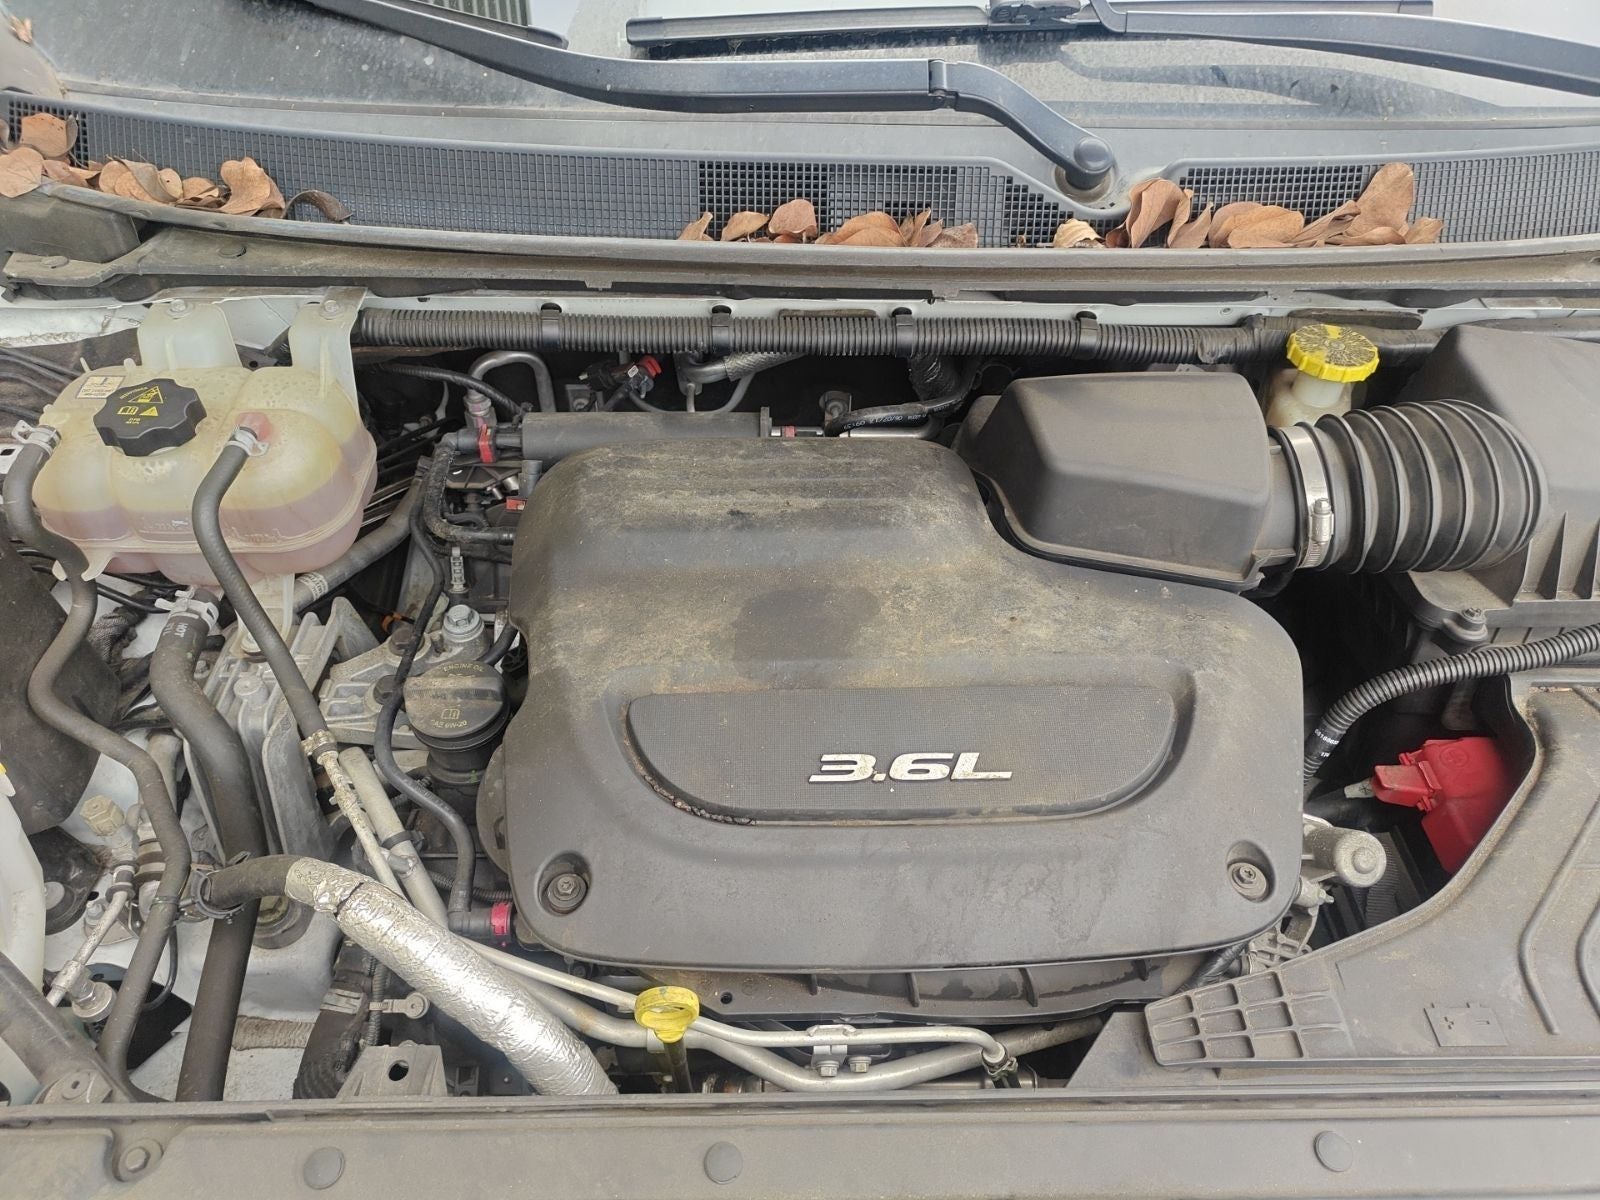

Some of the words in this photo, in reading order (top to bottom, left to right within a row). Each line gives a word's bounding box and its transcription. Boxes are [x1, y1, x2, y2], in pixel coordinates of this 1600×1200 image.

[174, 622, 189, 638] HOT
[443, 663, 472, 672] ENGINE
[808, 752, 1013, 783] 3.6L
